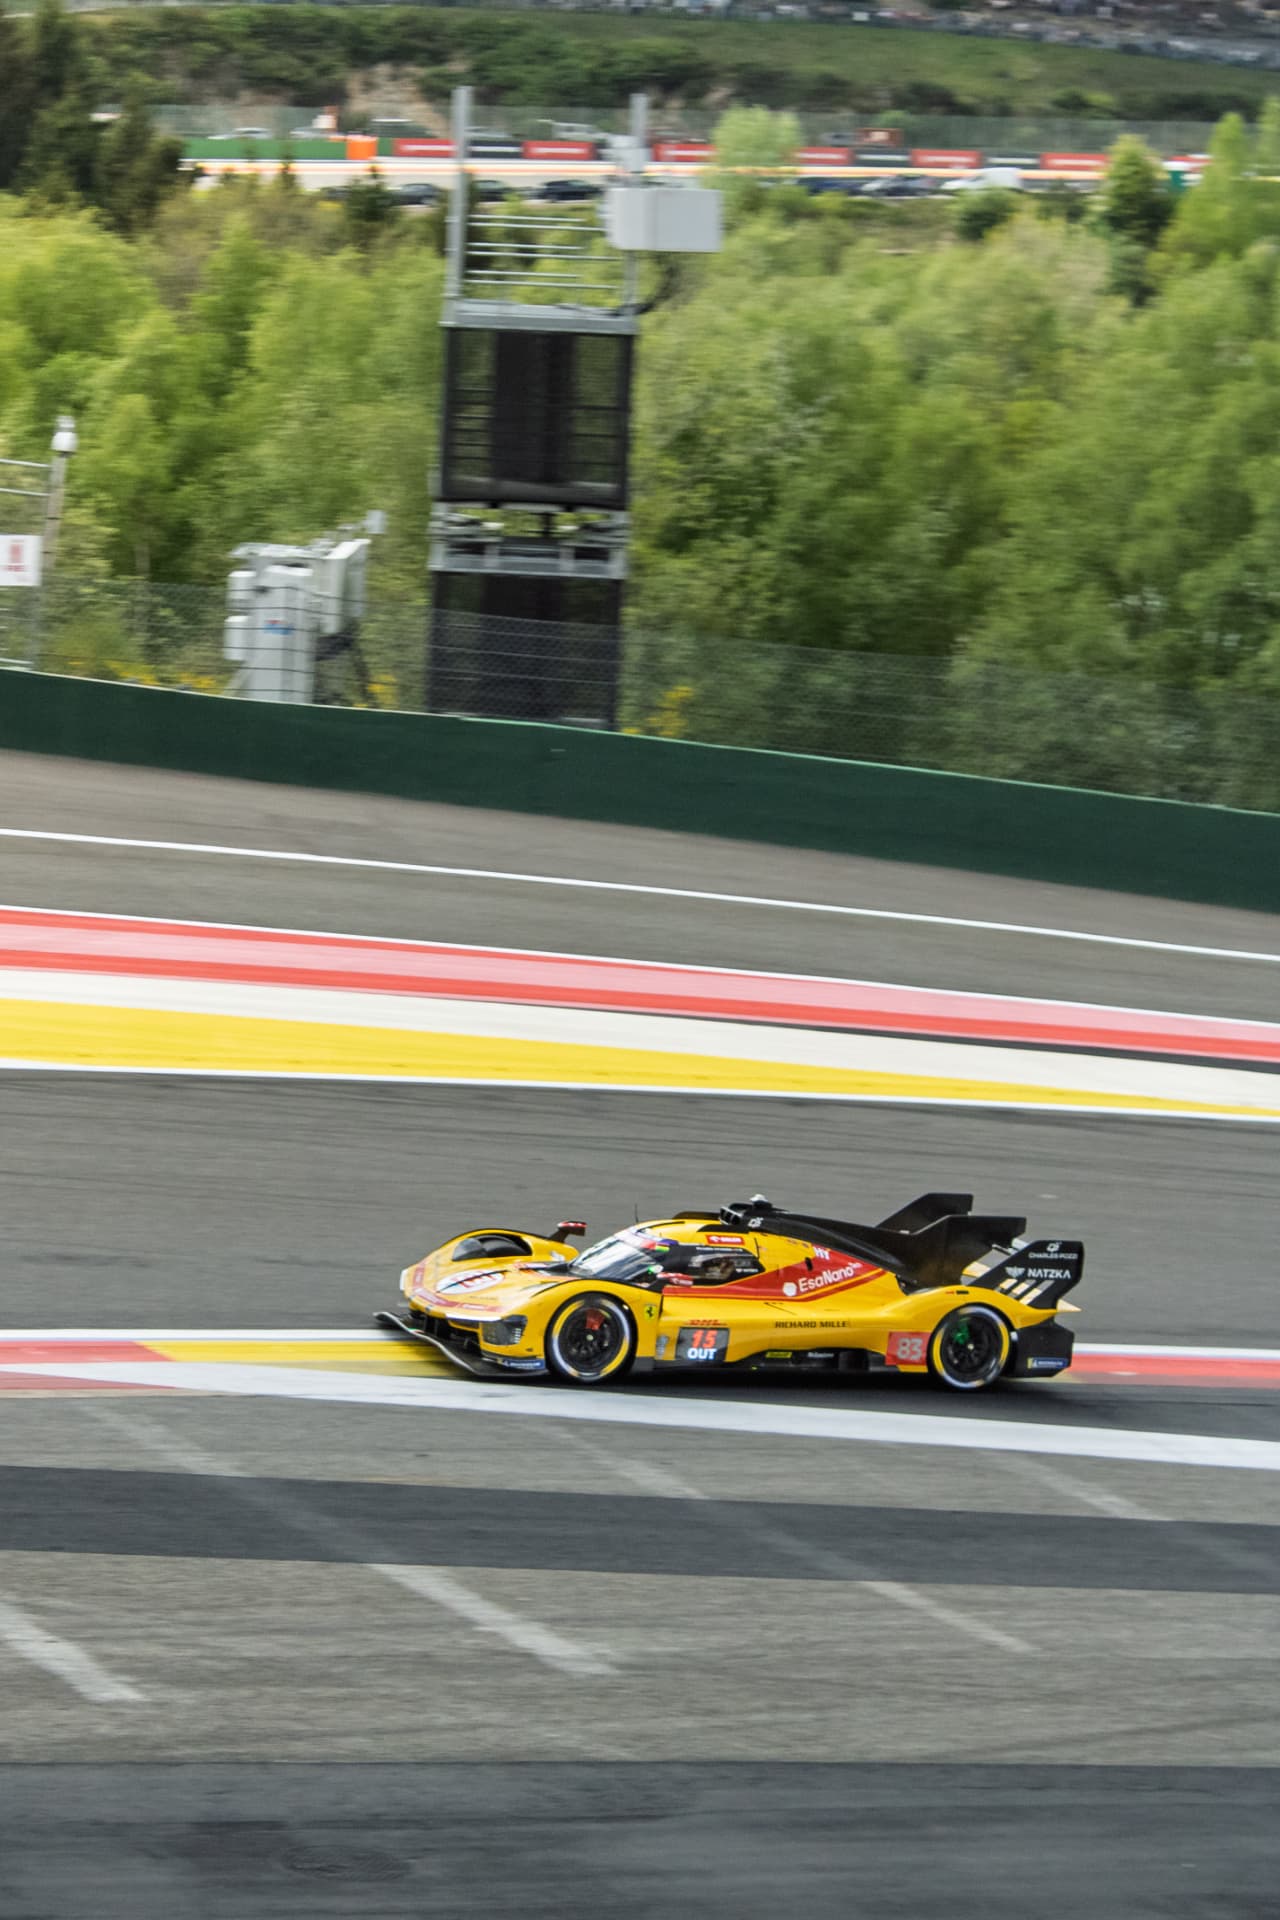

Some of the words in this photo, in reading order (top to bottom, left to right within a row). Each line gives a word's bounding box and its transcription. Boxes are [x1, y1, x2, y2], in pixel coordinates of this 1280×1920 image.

[799, 1266, 854, 1292] EsaNano
[1027, 1267, 1071, 1279] NATZKA
[775, 1321, 816, 1329] RICHARD
[687, 1348, 717, 1360] OUT
[897, 1337, 923, 1360] 83
